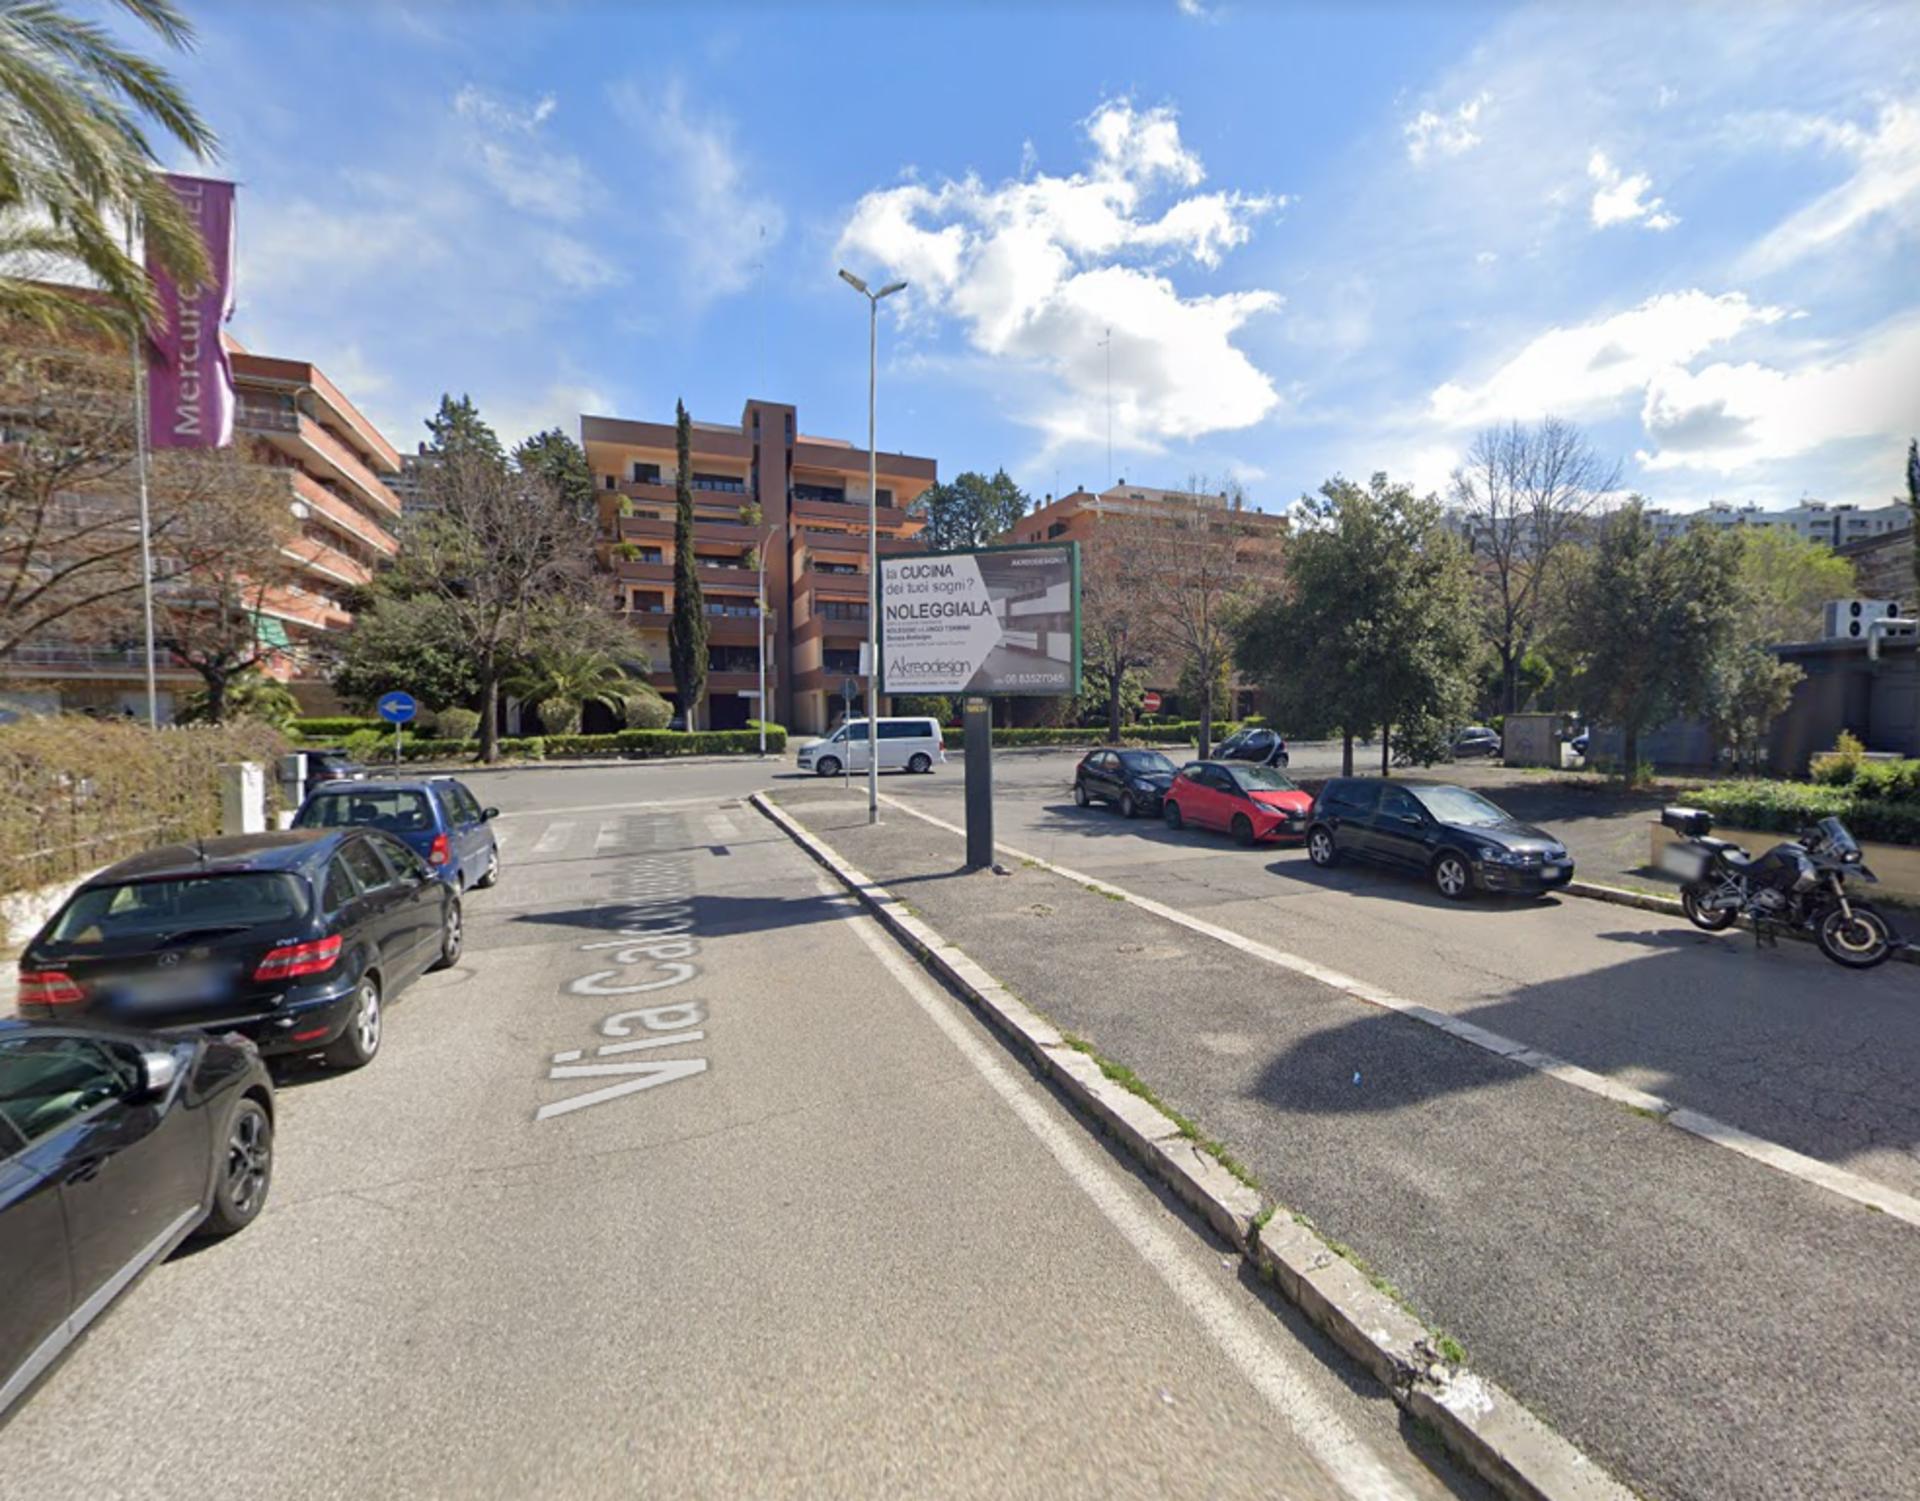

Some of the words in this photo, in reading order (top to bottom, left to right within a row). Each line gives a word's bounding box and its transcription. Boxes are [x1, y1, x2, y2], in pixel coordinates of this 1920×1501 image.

[174, 283, 201, 436] Mercure
[901, 564, 954, 579] CUCINA
[886, 582, 903, 595] dei
[907, 581, 929, 593] tuoi
[886, 600, 992, 620] NOLEGGIALA
